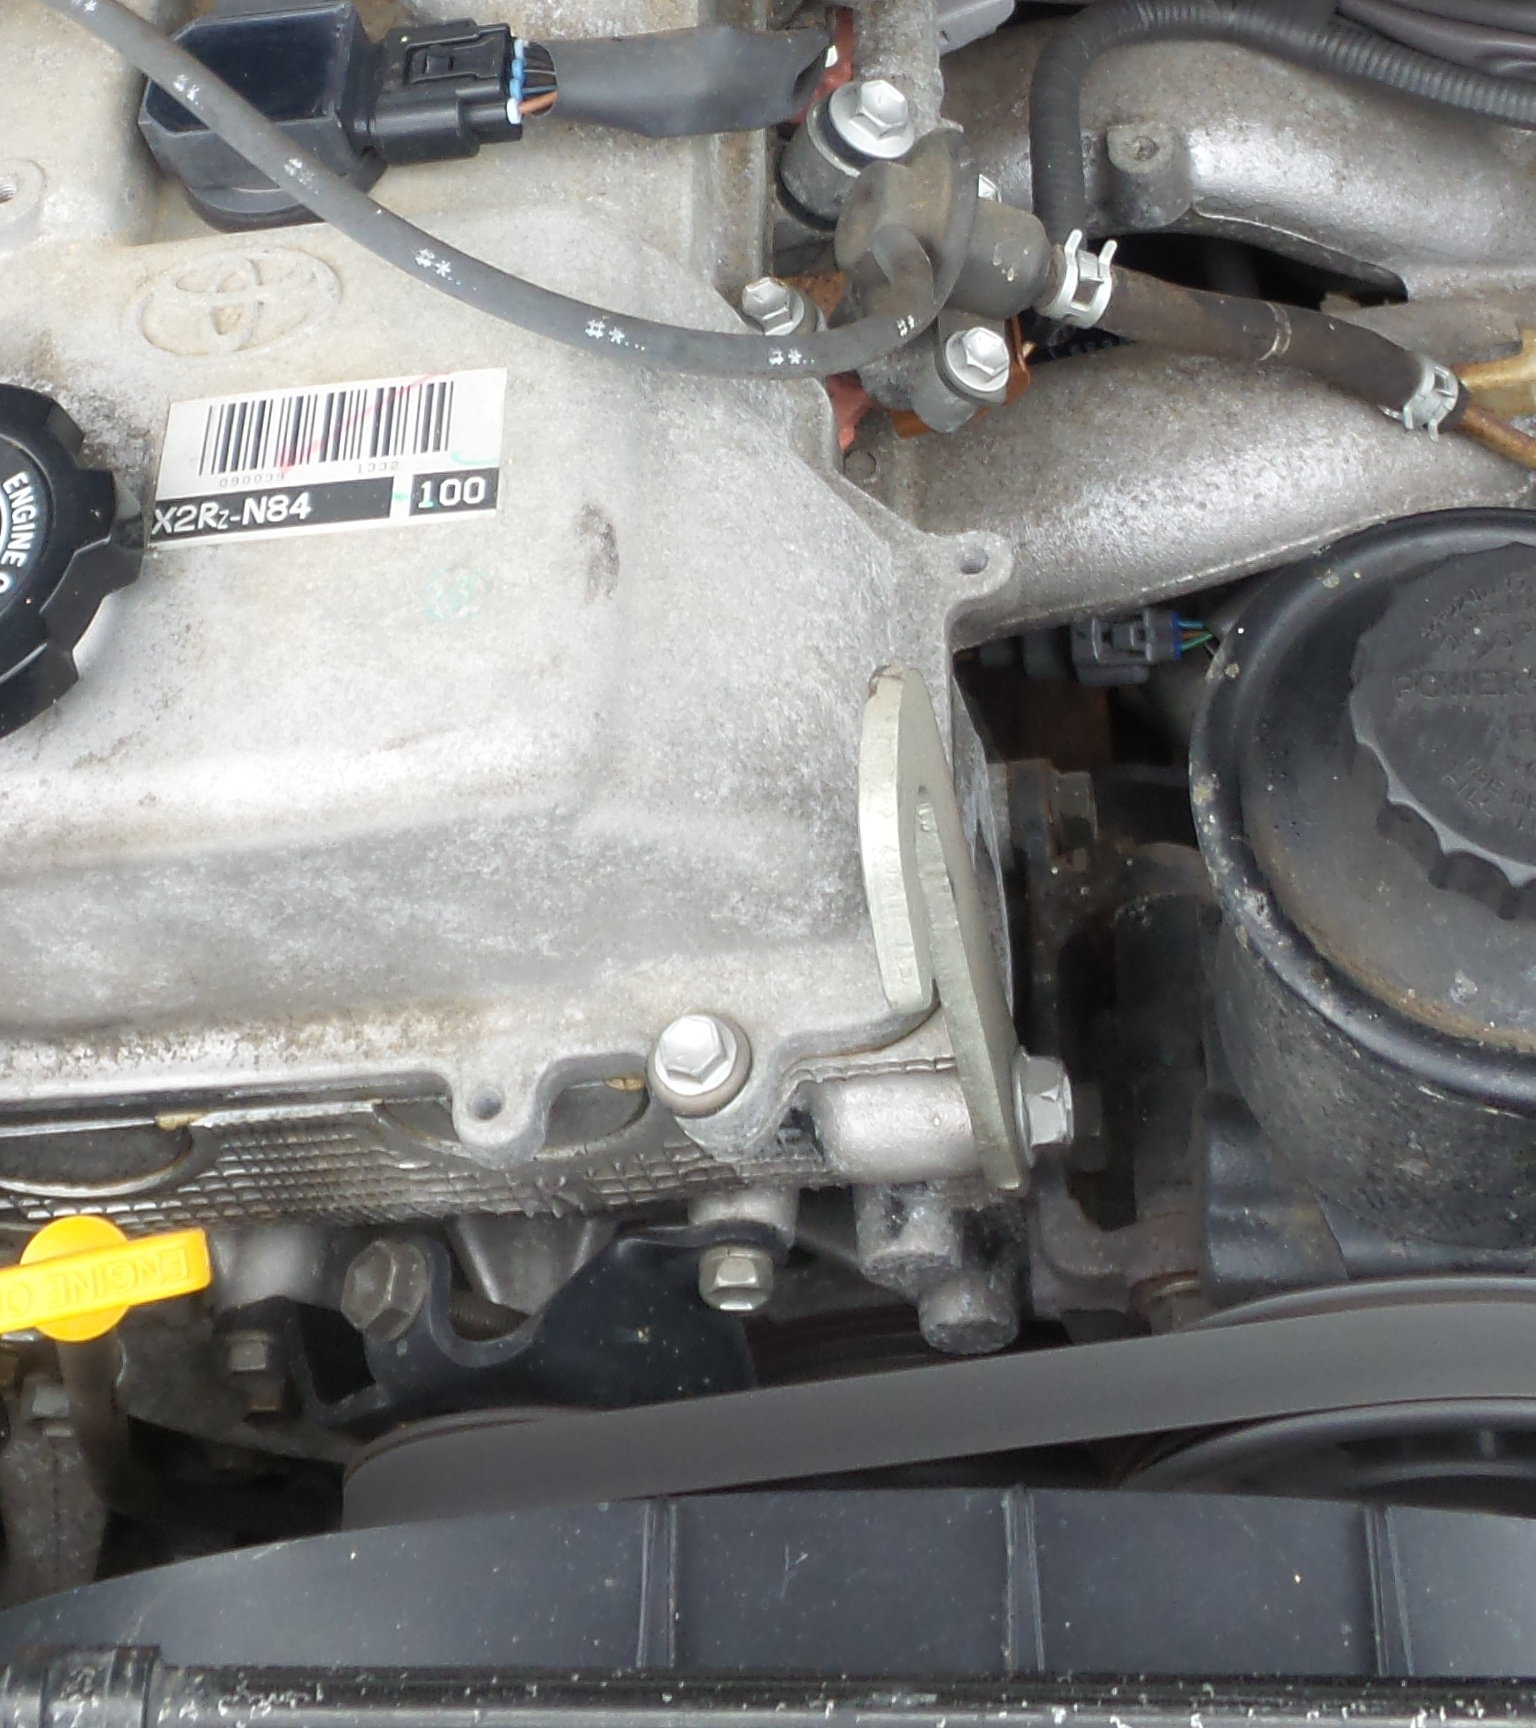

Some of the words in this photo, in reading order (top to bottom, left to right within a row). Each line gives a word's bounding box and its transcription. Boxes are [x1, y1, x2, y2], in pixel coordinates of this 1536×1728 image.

[417, 476, 486, 509] 100
[1, 471, 38, 568] ENGINE
[1390, 668, 1526, 701] POWER
[50, 1248, 190, 1308] ENGINE
